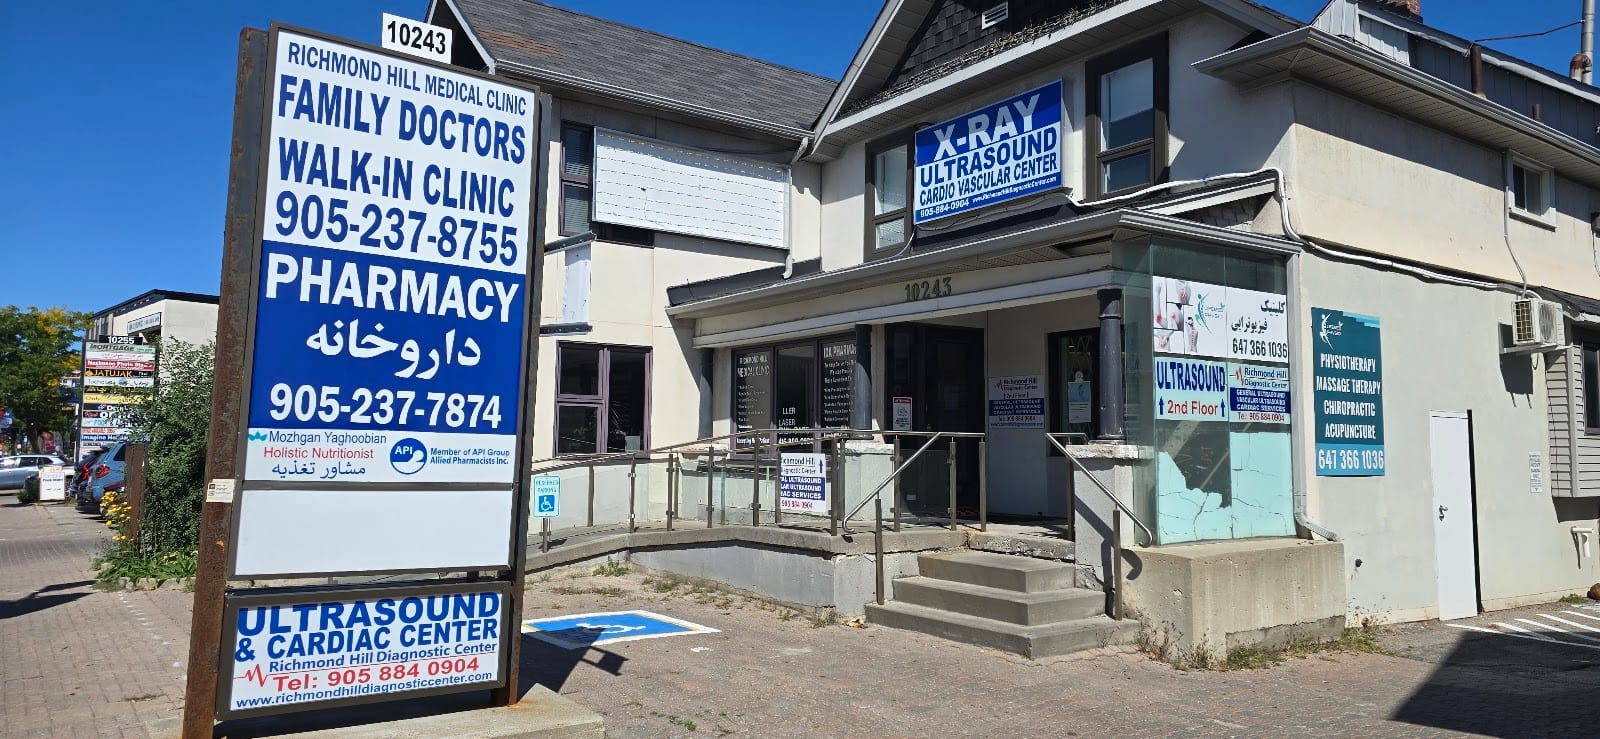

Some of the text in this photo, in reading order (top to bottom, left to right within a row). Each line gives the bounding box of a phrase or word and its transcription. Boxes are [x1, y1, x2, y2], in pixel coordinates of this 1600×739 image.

[387, 20, 446, 55] 10243
[288, 42, 526, 116] RICHMOND HILL MEDICAL CLINIC
[278, 74, 526, 164] FAMILY DOCTORS
[933, 93, 1041, 162] X-RAY
[920, 126, 1057, 188] ULTRASOUND
[279, 137, 515, 218] WALK-IN CLINIC
[919, 152, 1058, 206] CARDIO VASCULAR CENTER
[920, 198, 970, 218] 905-884-0904
[275, 190, 518, 267] 905-237-8755
[265, 252, 519, 323] PHARMACY
[905, 276, 952, 301] 10243
[90, 344, 135, 352] MORTGAGE
[108, 336, 135, 344] 10255
[306, 319, 481, 380] داروخانه
[1232, 338, 1288, 358] 647 366 1036
[1244, 367, 1287, 378] Richmond Hill
[1320, 353, 1376, 372] PHYSIOTHERAPY
[94, 370, 133, 378] JATUJAK
[1156, 361, 1226, 393] ULTRASOUND
[1244, 379, 1271, 388] Diagnostic
[1316, 375, 1381, 395] MASSAGE THERAPY
[270, 382, 502, 429] 905-237-7874
[1167, 400, 1219, 415] 2nd Floor
[1260, 405, 1286, 413] SERVICES
[1324, 400, 1376, 416] CHIROPRACTIC
[81, 434, 106, 442] Imagine
[269, 431, 387, 446] Mozhgan Yaghoobian
[1325, 423, 1377, 439] ACUPUNCTURE
[263, 447, 374, 459] Holistic Nutritionist
[394, 446, 413, 455] API
[430, 448, 510, 457] Member of API Group
[1318, 449, 1384, 470] 647 366 1036
[271, 460, 366, 479] مشاور تغذیه
[429, 457, 509, 465] Allied Pharmacists Inc.
[789, 476, 822, 484] ULTRASOUND
[790, 484, 822, 492] ULTRASOUND
[792, 491, 822, 499] SERVICES
[237, 591, 500, 636] ULTRASOUND
[234, 618, 498, 662] & CARDIAC CENTER
[269, 642, 498, 672] Richmond Hill Diagnostic Center
[273, 657, 479, 692] Tel: 905 884 0904
[236, 672, 492, 708] www.richmondhilldiagnosticcenter.com
